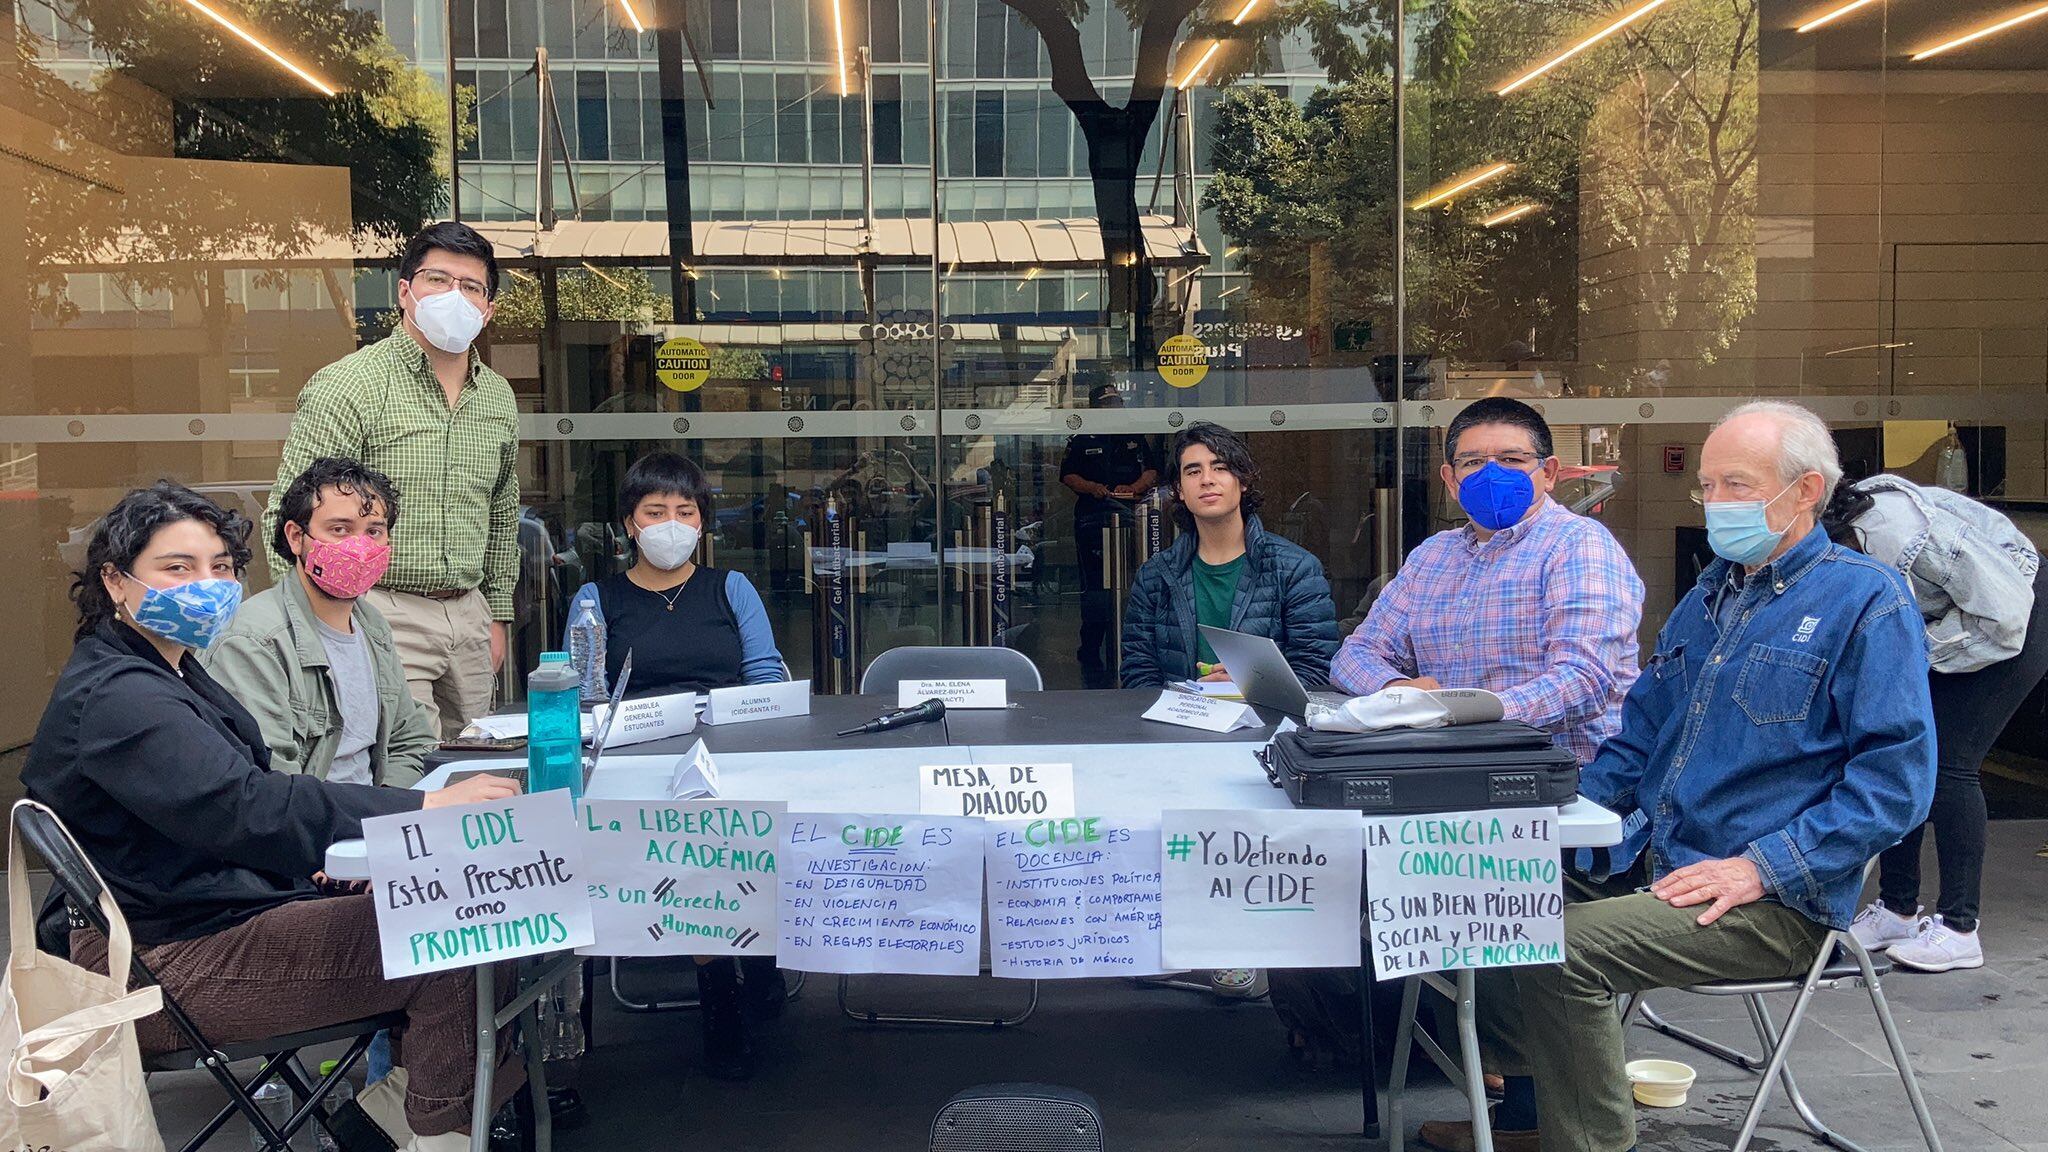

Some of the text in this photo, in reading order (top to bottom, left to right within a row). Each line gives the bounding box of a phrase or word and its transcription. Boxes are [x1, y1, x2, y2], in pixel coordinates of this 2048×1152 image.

[661, 348, 706, 356] AUTOMATIC
[1160, 355, 1207, 365] CAUTION
[658, 359, 707, 369] CAUTION
[1172, 368, 1194, 376] DOOR
[672, 372, 695, 380] DOOR
[831, 519, 843, 605] Gel Antibacterial
[995, 517, 1006, 602] Gel Antibacterial
[624, 701, 660, 712] ASAMBLEA
[624, 710, 663, 722] GENERAL DE
[731, 704, 781, 717] (CIDE-SANTA FE)
[623, 720, 665, 731] ESTUDIANTES
[933, 765, 1038, 788] MESA DE
[588, 806, 773, 838] La LIBERTAD
[996, 816, 1131, 848] EL CIDE ES
[1368, 822, 1390, 848] LA
[1399, 816, 1505, 846] CIENCIA
[1531, 818, 1550, 842] EL
[401, 807, 525, 861] EL CIDE
[790, 823, 953, 850] EL CIDE ES
[644, 839, 777, 874] ACADÉMICA
[1398, 850, 1557, 884] CONOCIMIENTO
[463, 848, 573, 899] Presente
[824, 876, 928, 892] DESIGUALDAD
[1243, 874, 1316, 906] CIDE
[455, 899, 507, 922] como
[822, 897, 898, 910] VIOLENCIA
[1369, 898, 1396, 923] ES
[1400, 896, 1429, 919] UN
[1432, 892, 1477, 918] BIEN
[822, 916, 915, 930] CRECIMIENTO
[1085, 913, 1107, 924] CON
[410, 911, 569, 966] PROMETIMOS
[823, 935, 874, 948] REGLAS
[878, 937, 965, 955] ELECTORALES
[1377, 924, 1443, 952] SOCIAL
[1467, 920, 1531, 943] PILAR
[1070, 955, 1085, 966] DE
[1384, 941, 1560, 971] DE LA DEMOCRACIA
